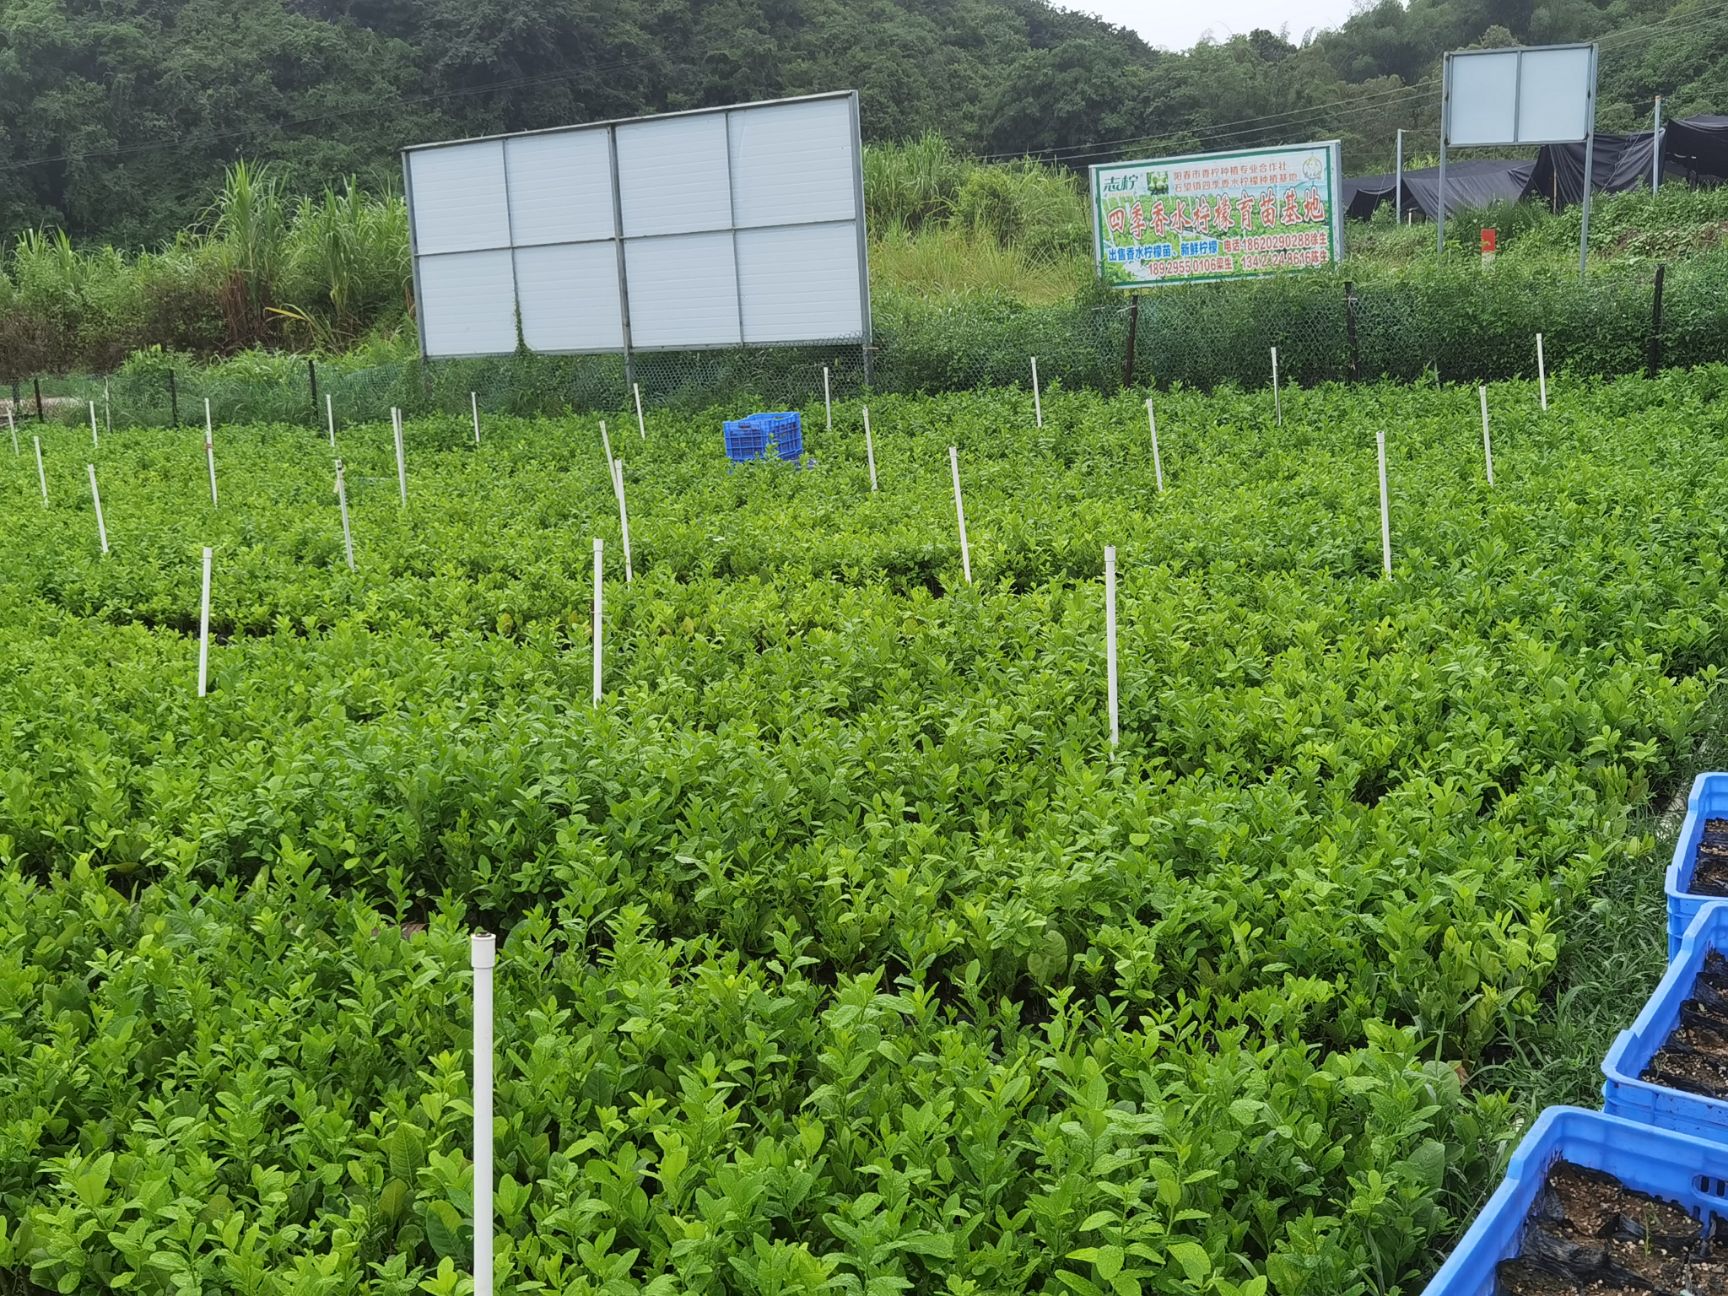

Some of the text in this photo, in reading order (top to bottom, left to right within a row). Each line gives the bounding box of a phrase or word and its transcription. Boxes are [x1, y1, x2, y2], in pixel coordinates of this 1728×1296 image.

[1108, 188, 1325, 239] 四季香水柠檬育苗基地
